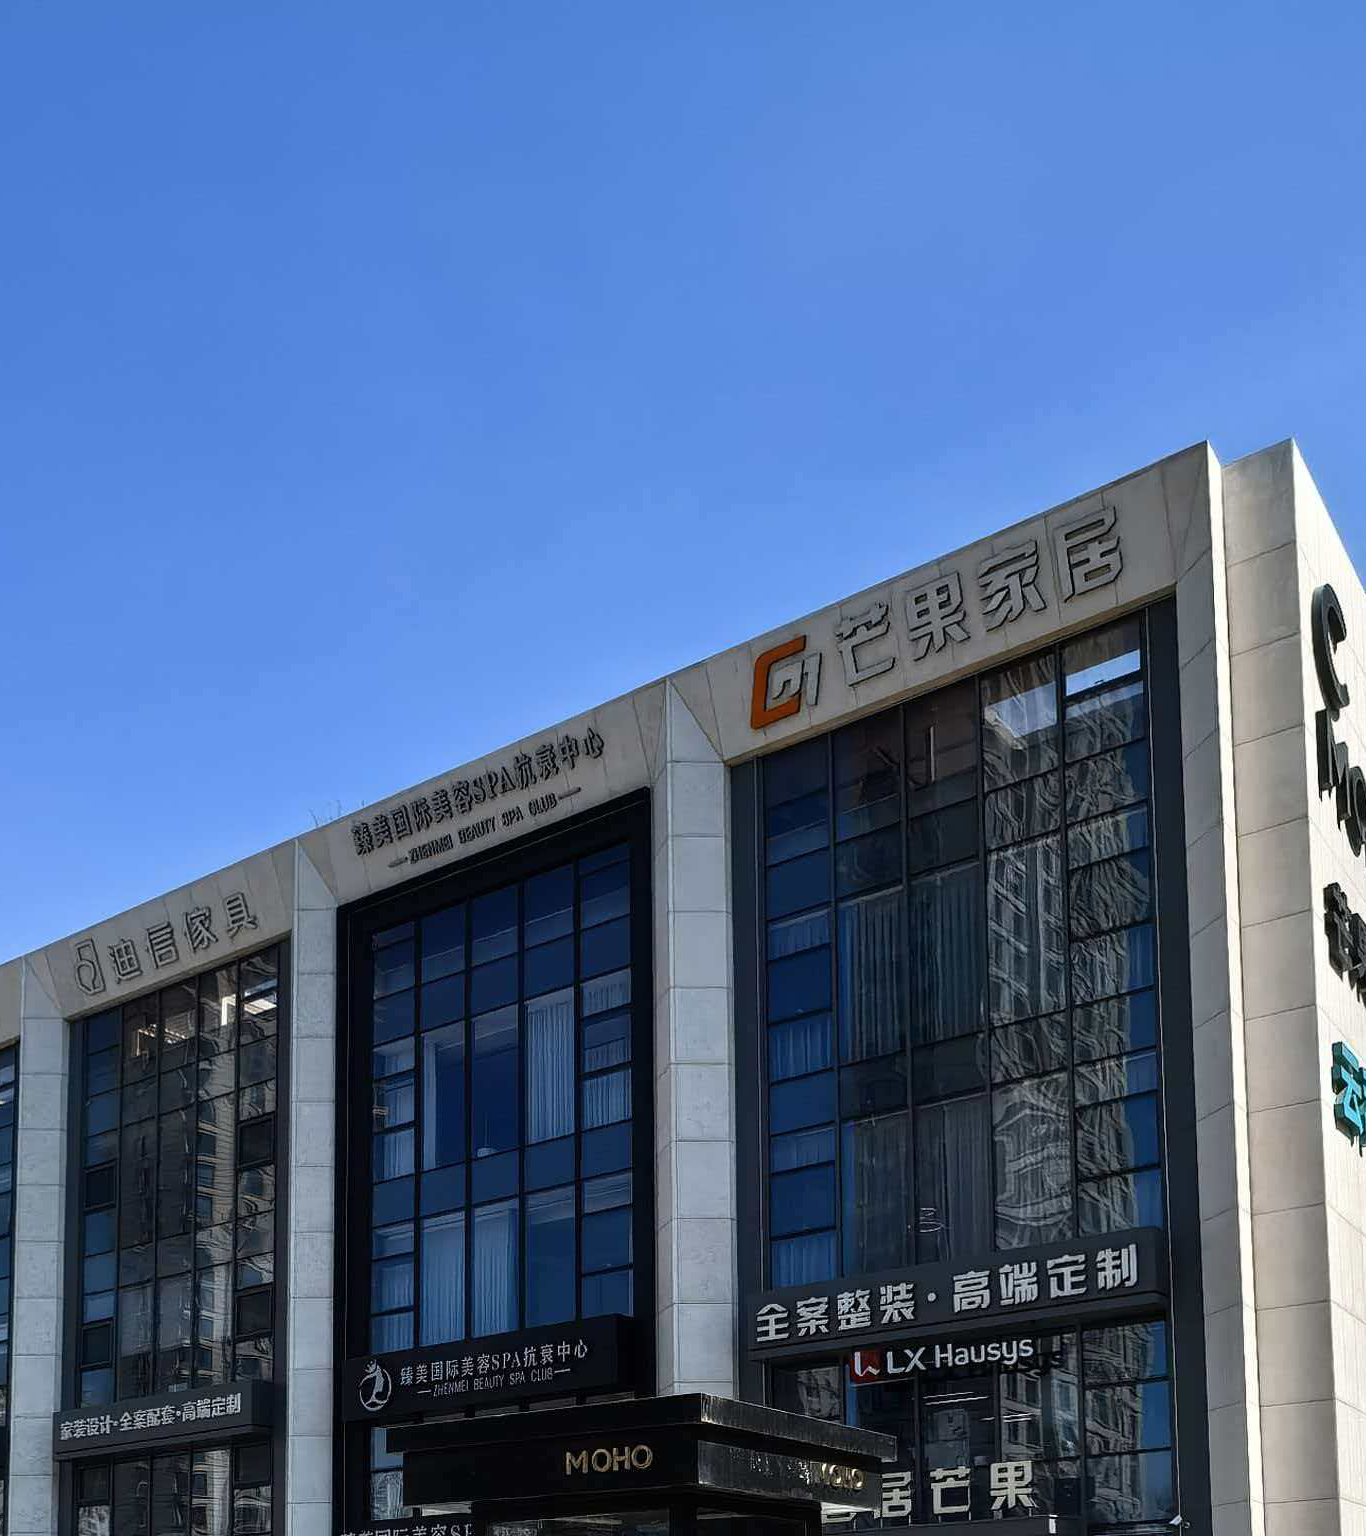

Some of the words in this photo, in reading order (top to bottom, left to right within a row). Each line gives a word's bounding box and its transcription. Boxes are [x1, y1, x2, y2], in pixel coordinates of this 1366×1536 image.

[836, 506, 1123, 688] 芒果家居
[352, 727, 605, 857] 臻美国际美容SPA抗衰中心
[458, 816, 496, 845] BEAUTY
[501, 805, 524, 829] SPA
[528, 792, 558, 816] CLUB
[107, 892, 258, 984] 迪信傢具
[755, 1243, 1139, 1343] 全案整装·高端定制
[400, 1339, 588, 1386] 臻美国际美容SPA抗衰中心
[433, 1381, 469, 1398] ZHENMEI
[473, 1375, 504, 1391] BEAUTY
[509, 1370, 525, 1385] SPA
[531, 1368, 553, 1382] CLUB
[887, 1347, 927, 1376] LX
[934, 1336, 1034, 1370] Hausys
[565, 1445, 653, 1475] MOHO
[821, 1461, 1037, 1523] 居芒果
